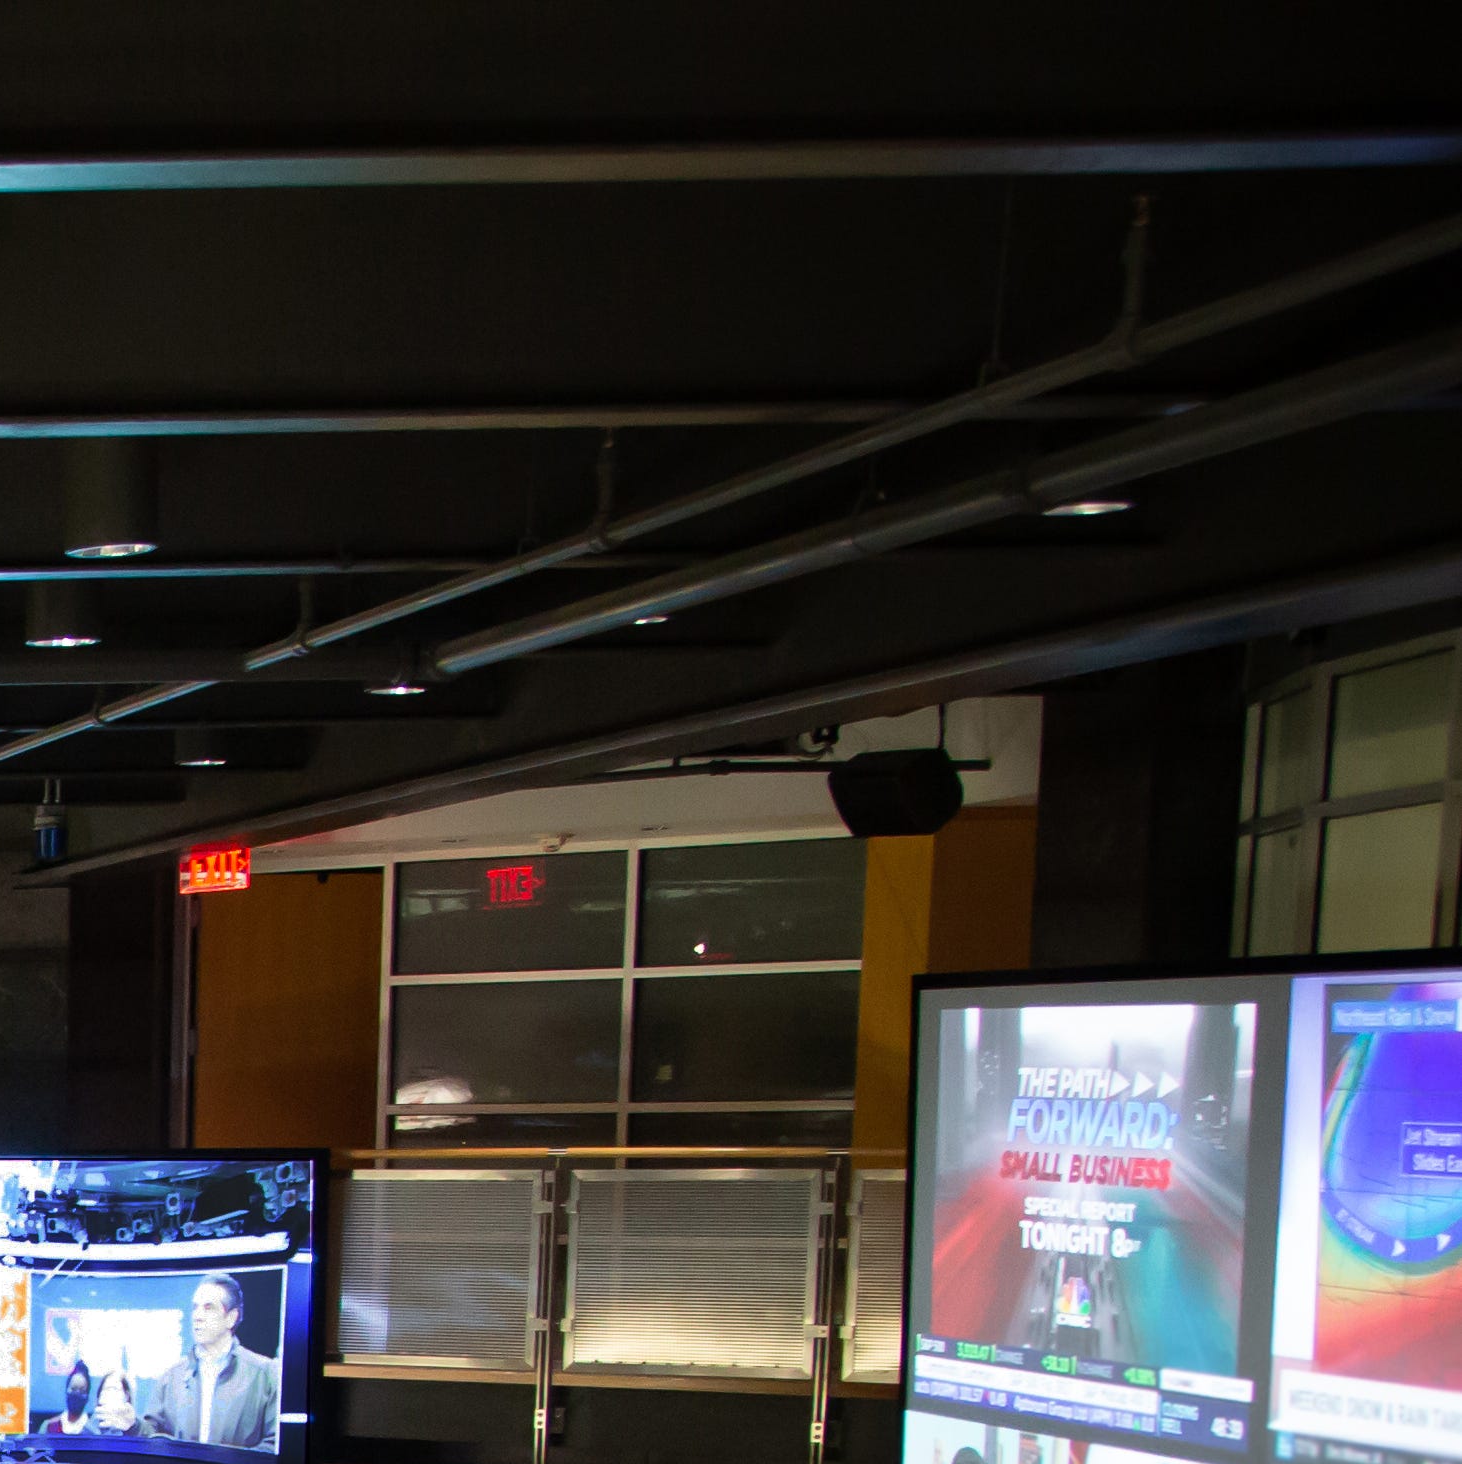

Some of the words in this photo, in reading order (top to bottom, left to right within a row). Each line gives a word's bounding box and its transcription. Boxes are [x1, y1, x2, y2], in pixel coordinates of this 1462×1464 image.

[190, 849, 241, 887] EXIT
[1018, 1067, 1058, 1098] THE
[1056, 1068, 1112, 1100] PATH
[1006, 1099, 1181, 1150] FORWARD:
[999, 1150, 1062, 1183] SMALL
[1068, 1154, 1173, 1192] BUSINESS
[1024, 1196, 1079, 1219] SPECIAL
[1079, 1199, 1136, 1222] REPORT
[1018, 1219, 1110, 1256] TONIGHT
